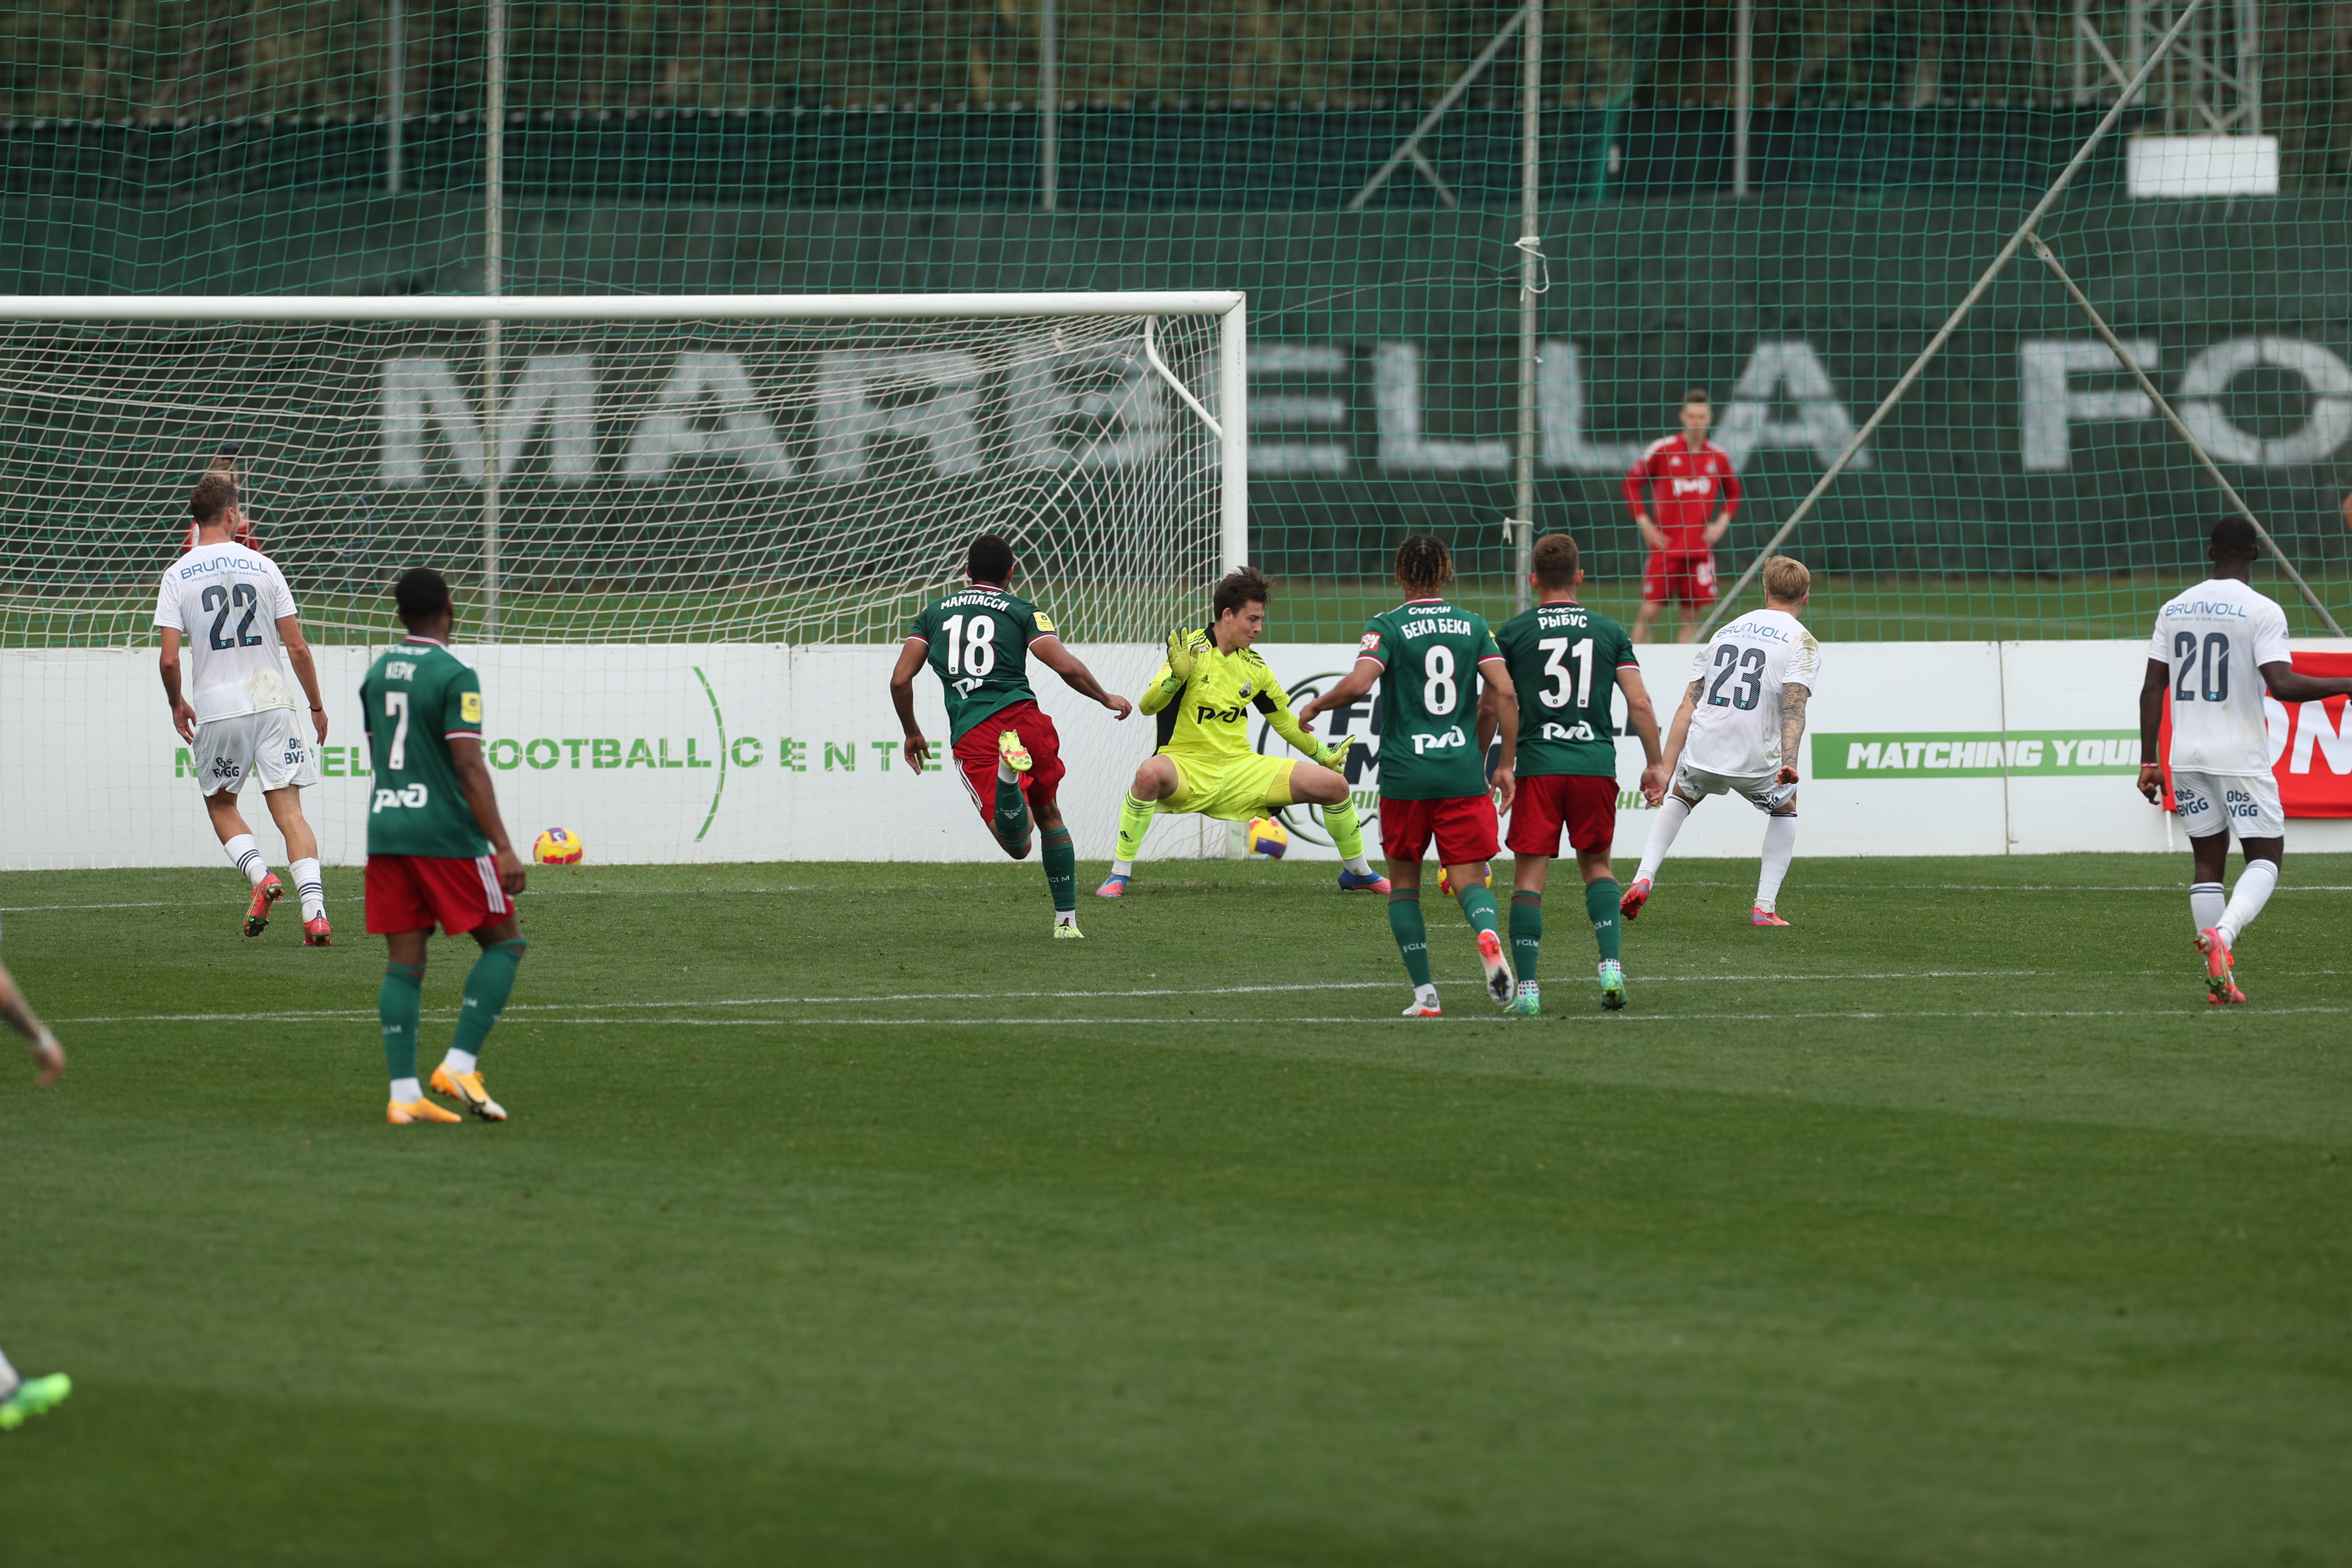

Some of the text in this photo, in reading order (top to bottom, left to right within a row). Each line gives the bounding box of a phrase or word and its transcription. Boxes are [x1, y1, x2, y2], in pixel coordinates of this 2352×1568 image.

[180, 557, 267, 580] BRUNVOLL
[191, 573, 218, 582] PRECISION
[940, 595, 1010, 611] МАМПАССИ
[2165, 601, 2247, 617] BRUNVOLL
[202, 583, 262, 651] 22
[1537, 614, 1588, 630] РЫБУС
[1400, 618, 1471, 640] БЕКА БЕКА
[1717, 622, 1789, 643] BRUNVOLL
[942, 614, 995, 676] 18
[1758, 637, 1779, 646] PASSION
[1538, 637, 1593, 709] 31
[1707, 644, 1766, 710] 23
[2174, 631, 2230, 701] 20
[1424, 645, 1457, 715] 8
[385, 691, 408, 770] 7
[481, 738, 712, 770] OOTBALL
[1847, 740, 2044, 769] MATCHING
[1472, 907, 1494, 918] FCLM
[1403, 942, 1427, 953] FCLM
[1516, 939, 1539, 947] FCLM
